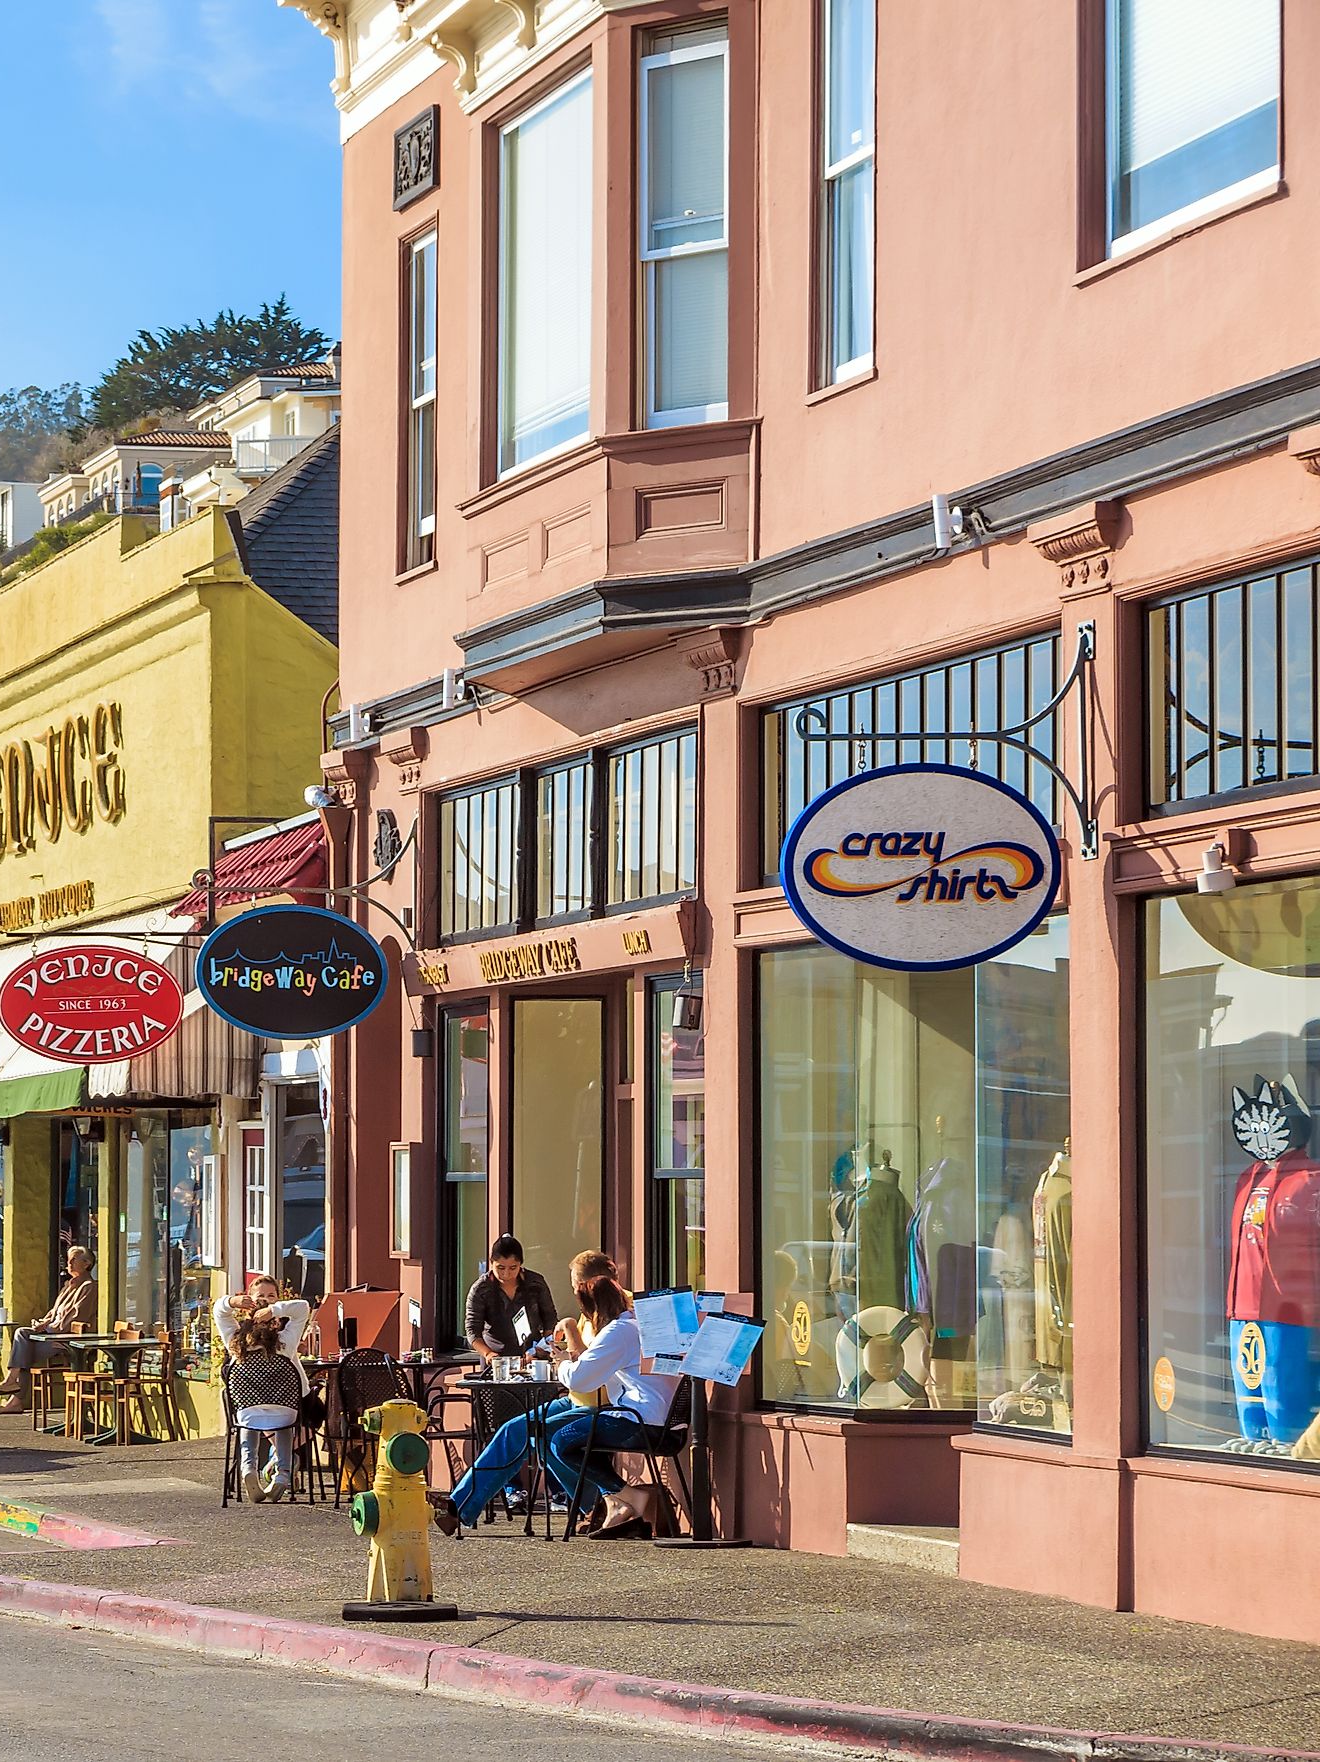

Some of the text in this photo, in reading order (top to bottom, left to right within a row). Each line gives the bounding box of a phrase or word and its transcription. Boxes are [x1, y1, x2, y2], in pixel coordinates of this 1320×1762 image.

[838, 832, 946, 863] crazy
[38, 880, 95, 921] BOUTIQUE
[895, 868, 1019, 903] shirts
[622, 929, 652, 956] LUNCH
[14, 954, 164, 997] VENICE
[321, 965, 375, 990] Cafe
[479, 943, 547, 983] BRIDGEWAY
[58, 998, 127, 1010] SINCE 1963
[20, 1012, 167, 1056] PIZZERIA
